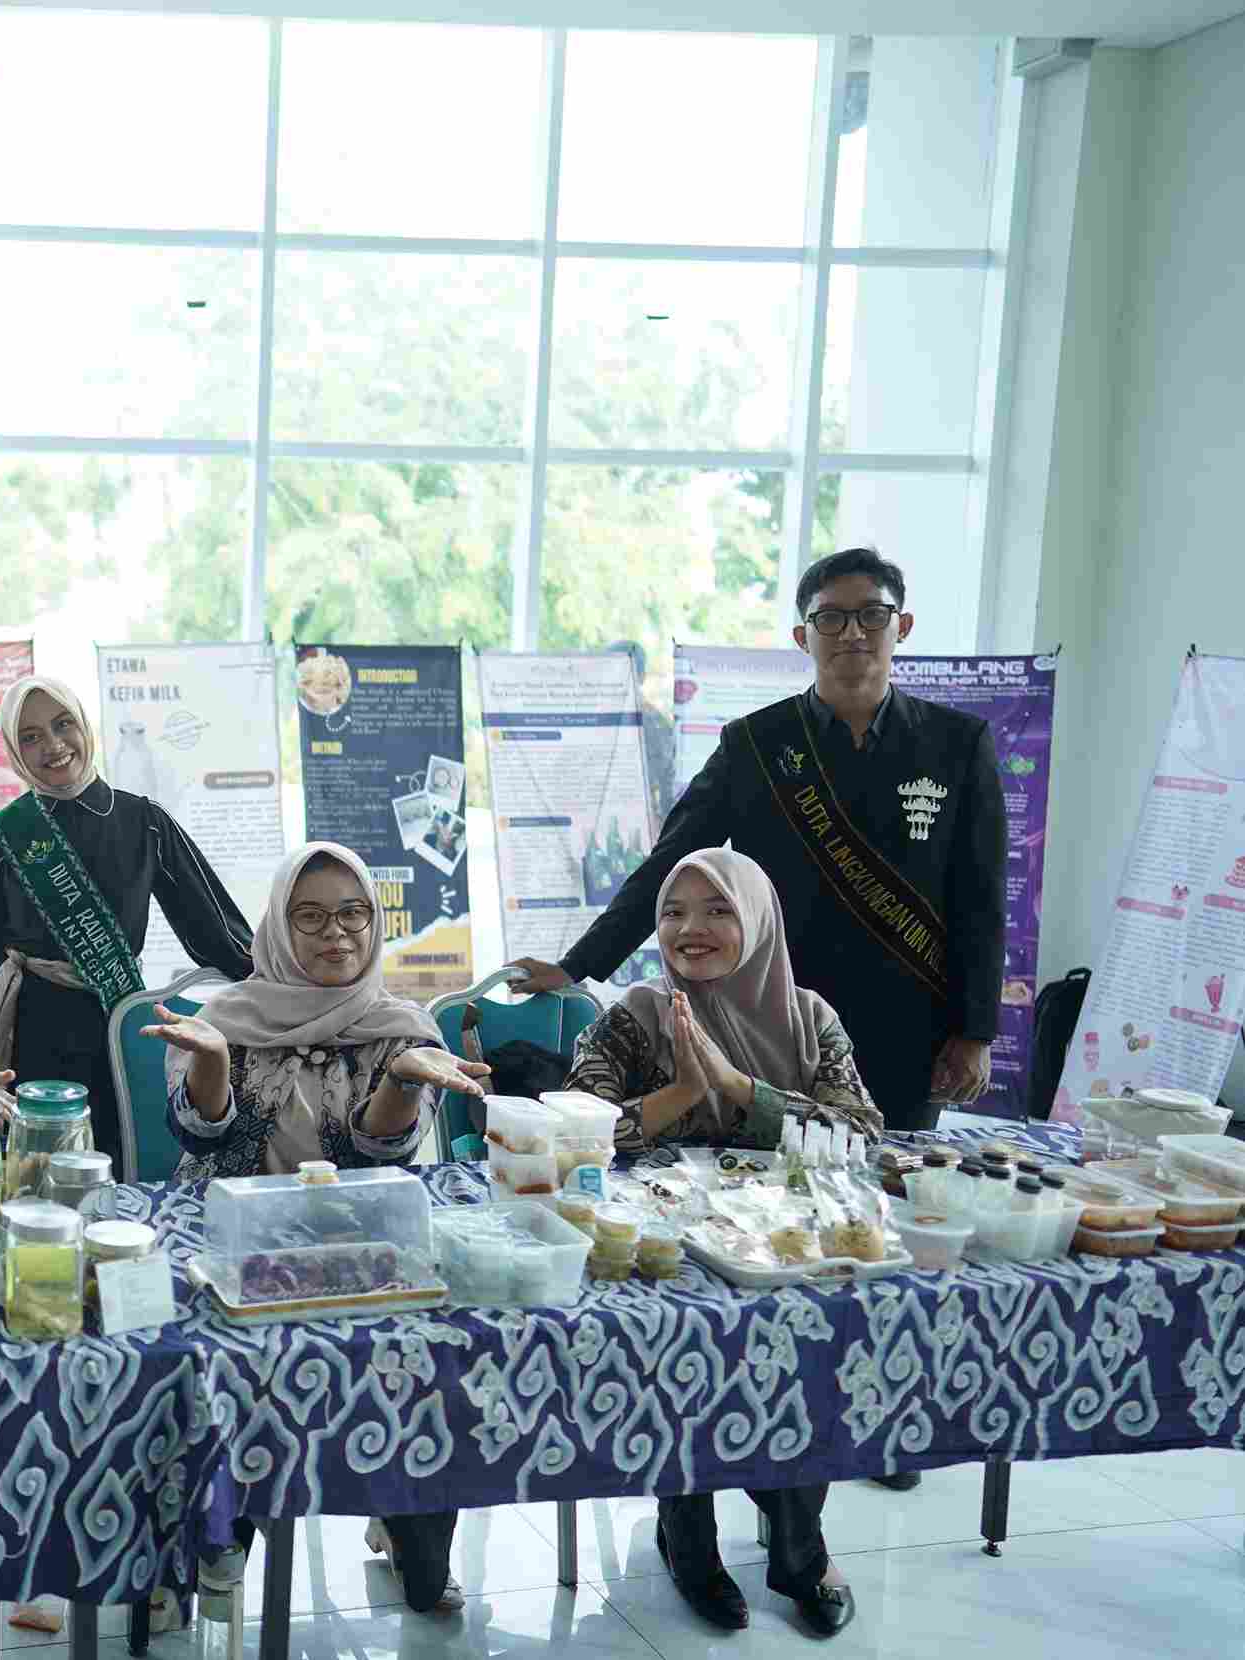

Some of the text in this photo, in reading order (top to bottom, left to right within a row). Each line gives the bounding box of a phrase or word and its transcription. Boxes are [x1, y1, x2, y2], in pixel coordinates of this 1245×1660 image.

[106, 657, 147, 673] ETAWA
[891, 661, 1026, 676] KOMBULANG
[109, 685, 181, 702] KEFIR MILK
[795, 785, 834, 838] DUTA
[825, 836, 915, 932] LINGKUNGAN
[47, 863, 83, 907] DUTA
[76, 908, 116, 959] RADEN
